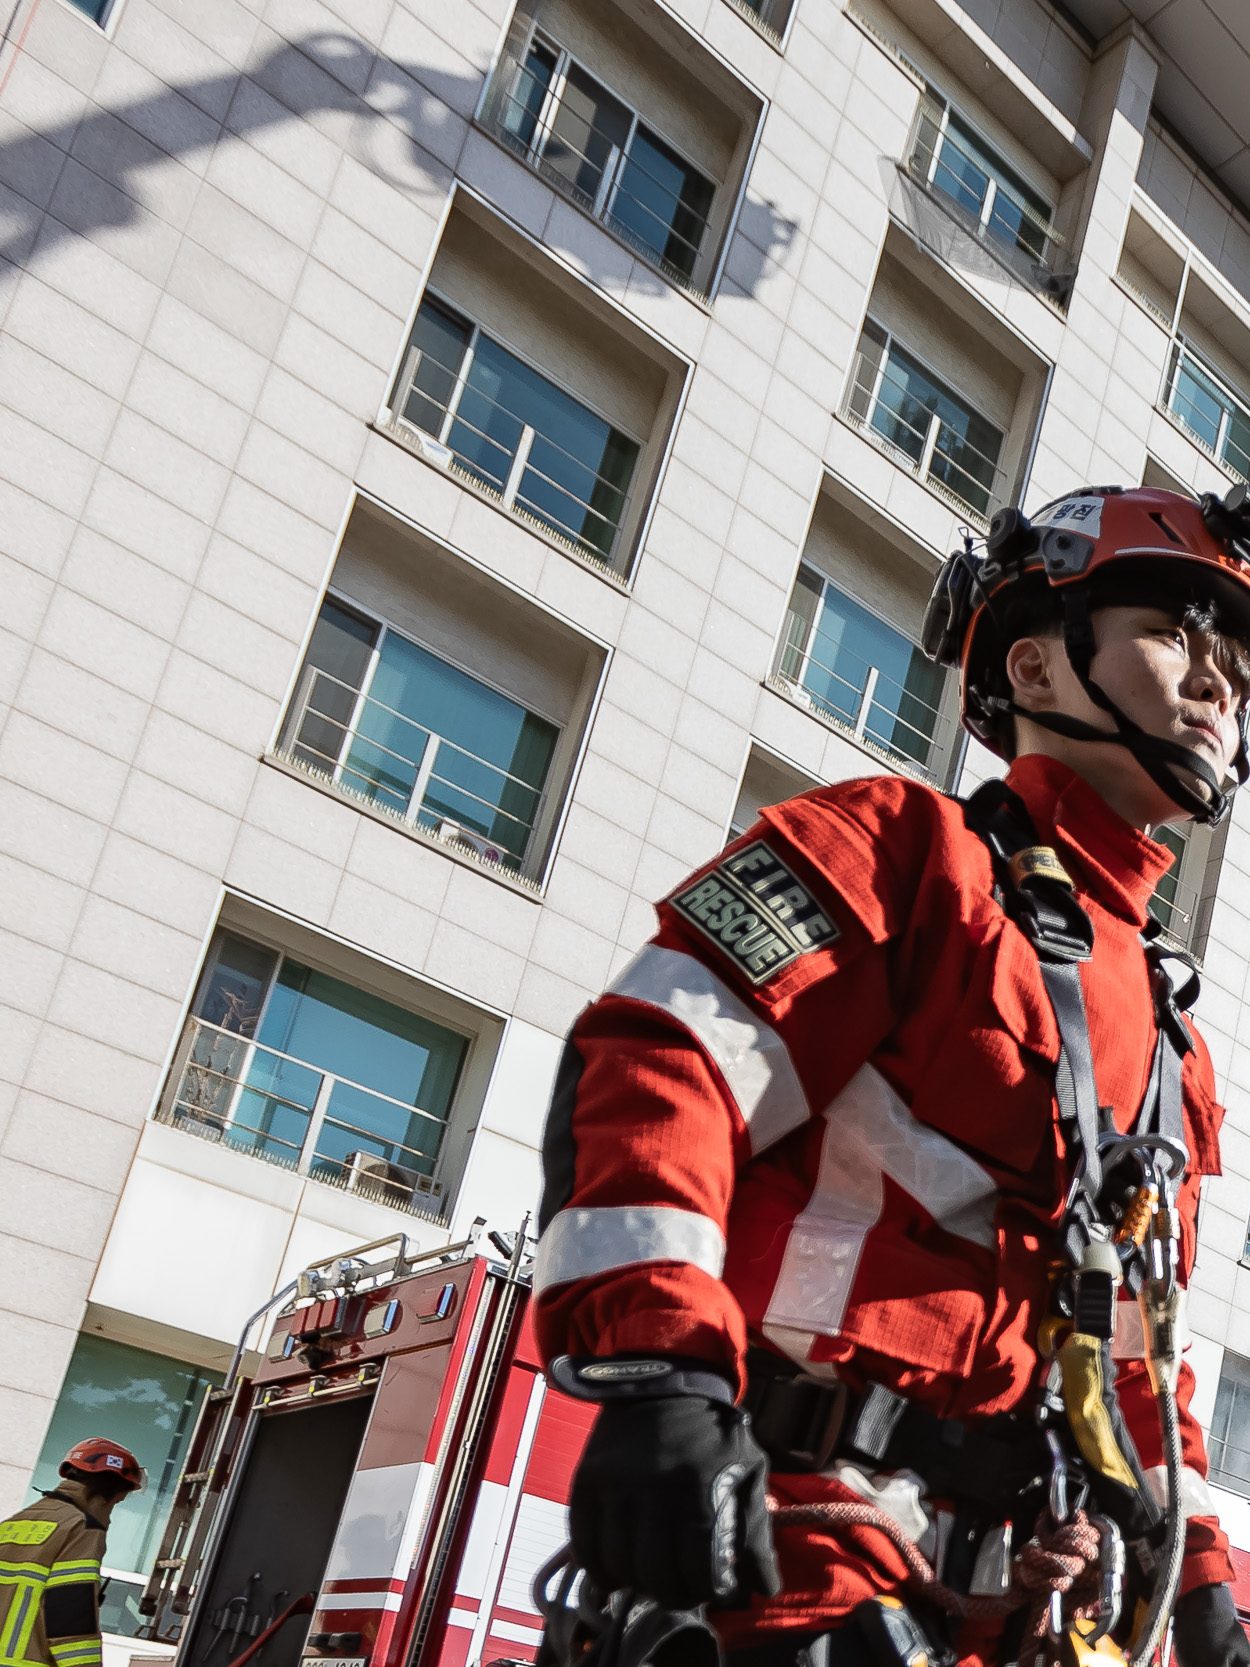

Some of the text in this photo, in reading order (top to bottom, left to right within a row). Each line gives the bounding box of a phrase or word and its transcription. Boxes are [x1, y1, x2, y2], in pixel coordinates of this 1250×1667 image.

[1053, 503, 1097, 521] 광진
[680, 878, 790, 973] RESCUE
[729, 847, 832, 947] FIRE
